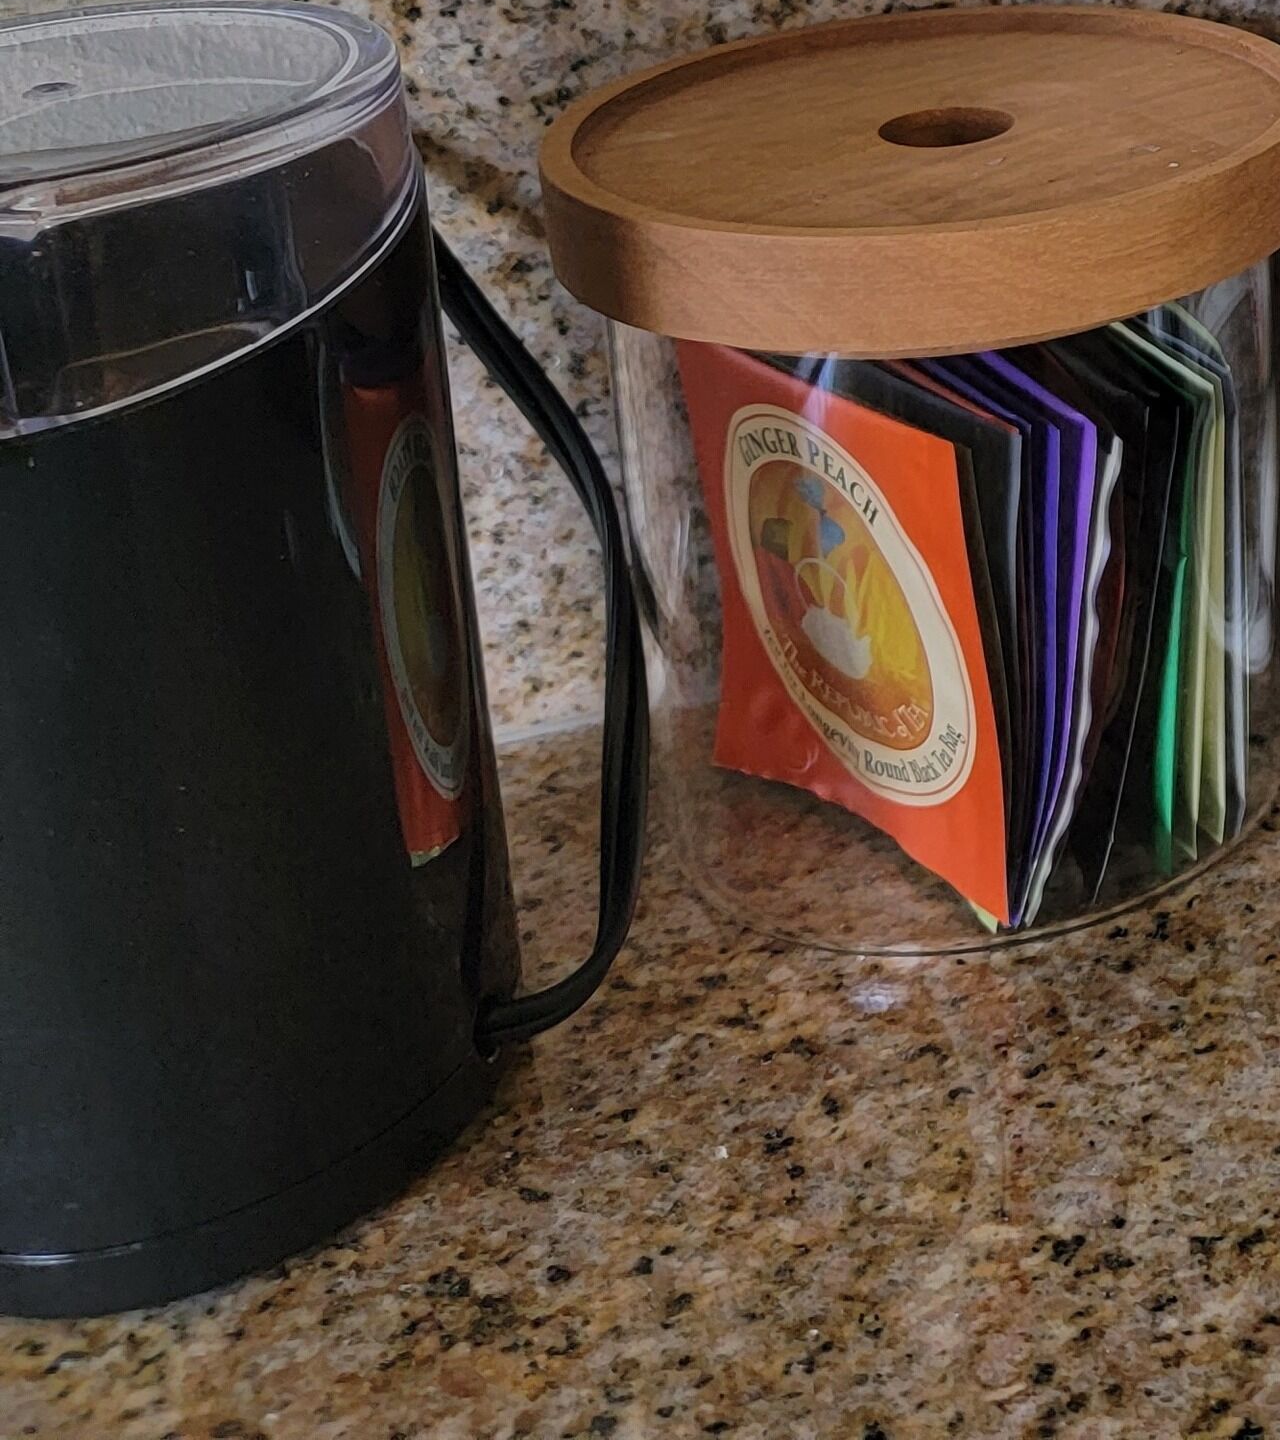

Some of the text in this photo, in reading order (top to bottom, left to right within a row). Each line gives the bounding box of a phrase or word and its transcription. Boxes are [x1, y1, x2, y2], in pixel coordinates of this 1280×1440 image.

[738, 427, 880, 527] GINGER PEACH
[938, 722, 966, 755] Bag
[863, 748, 912, 782] Round
[907, 755, 942, 782] Black
[930, 749, 954, 772] Tea
